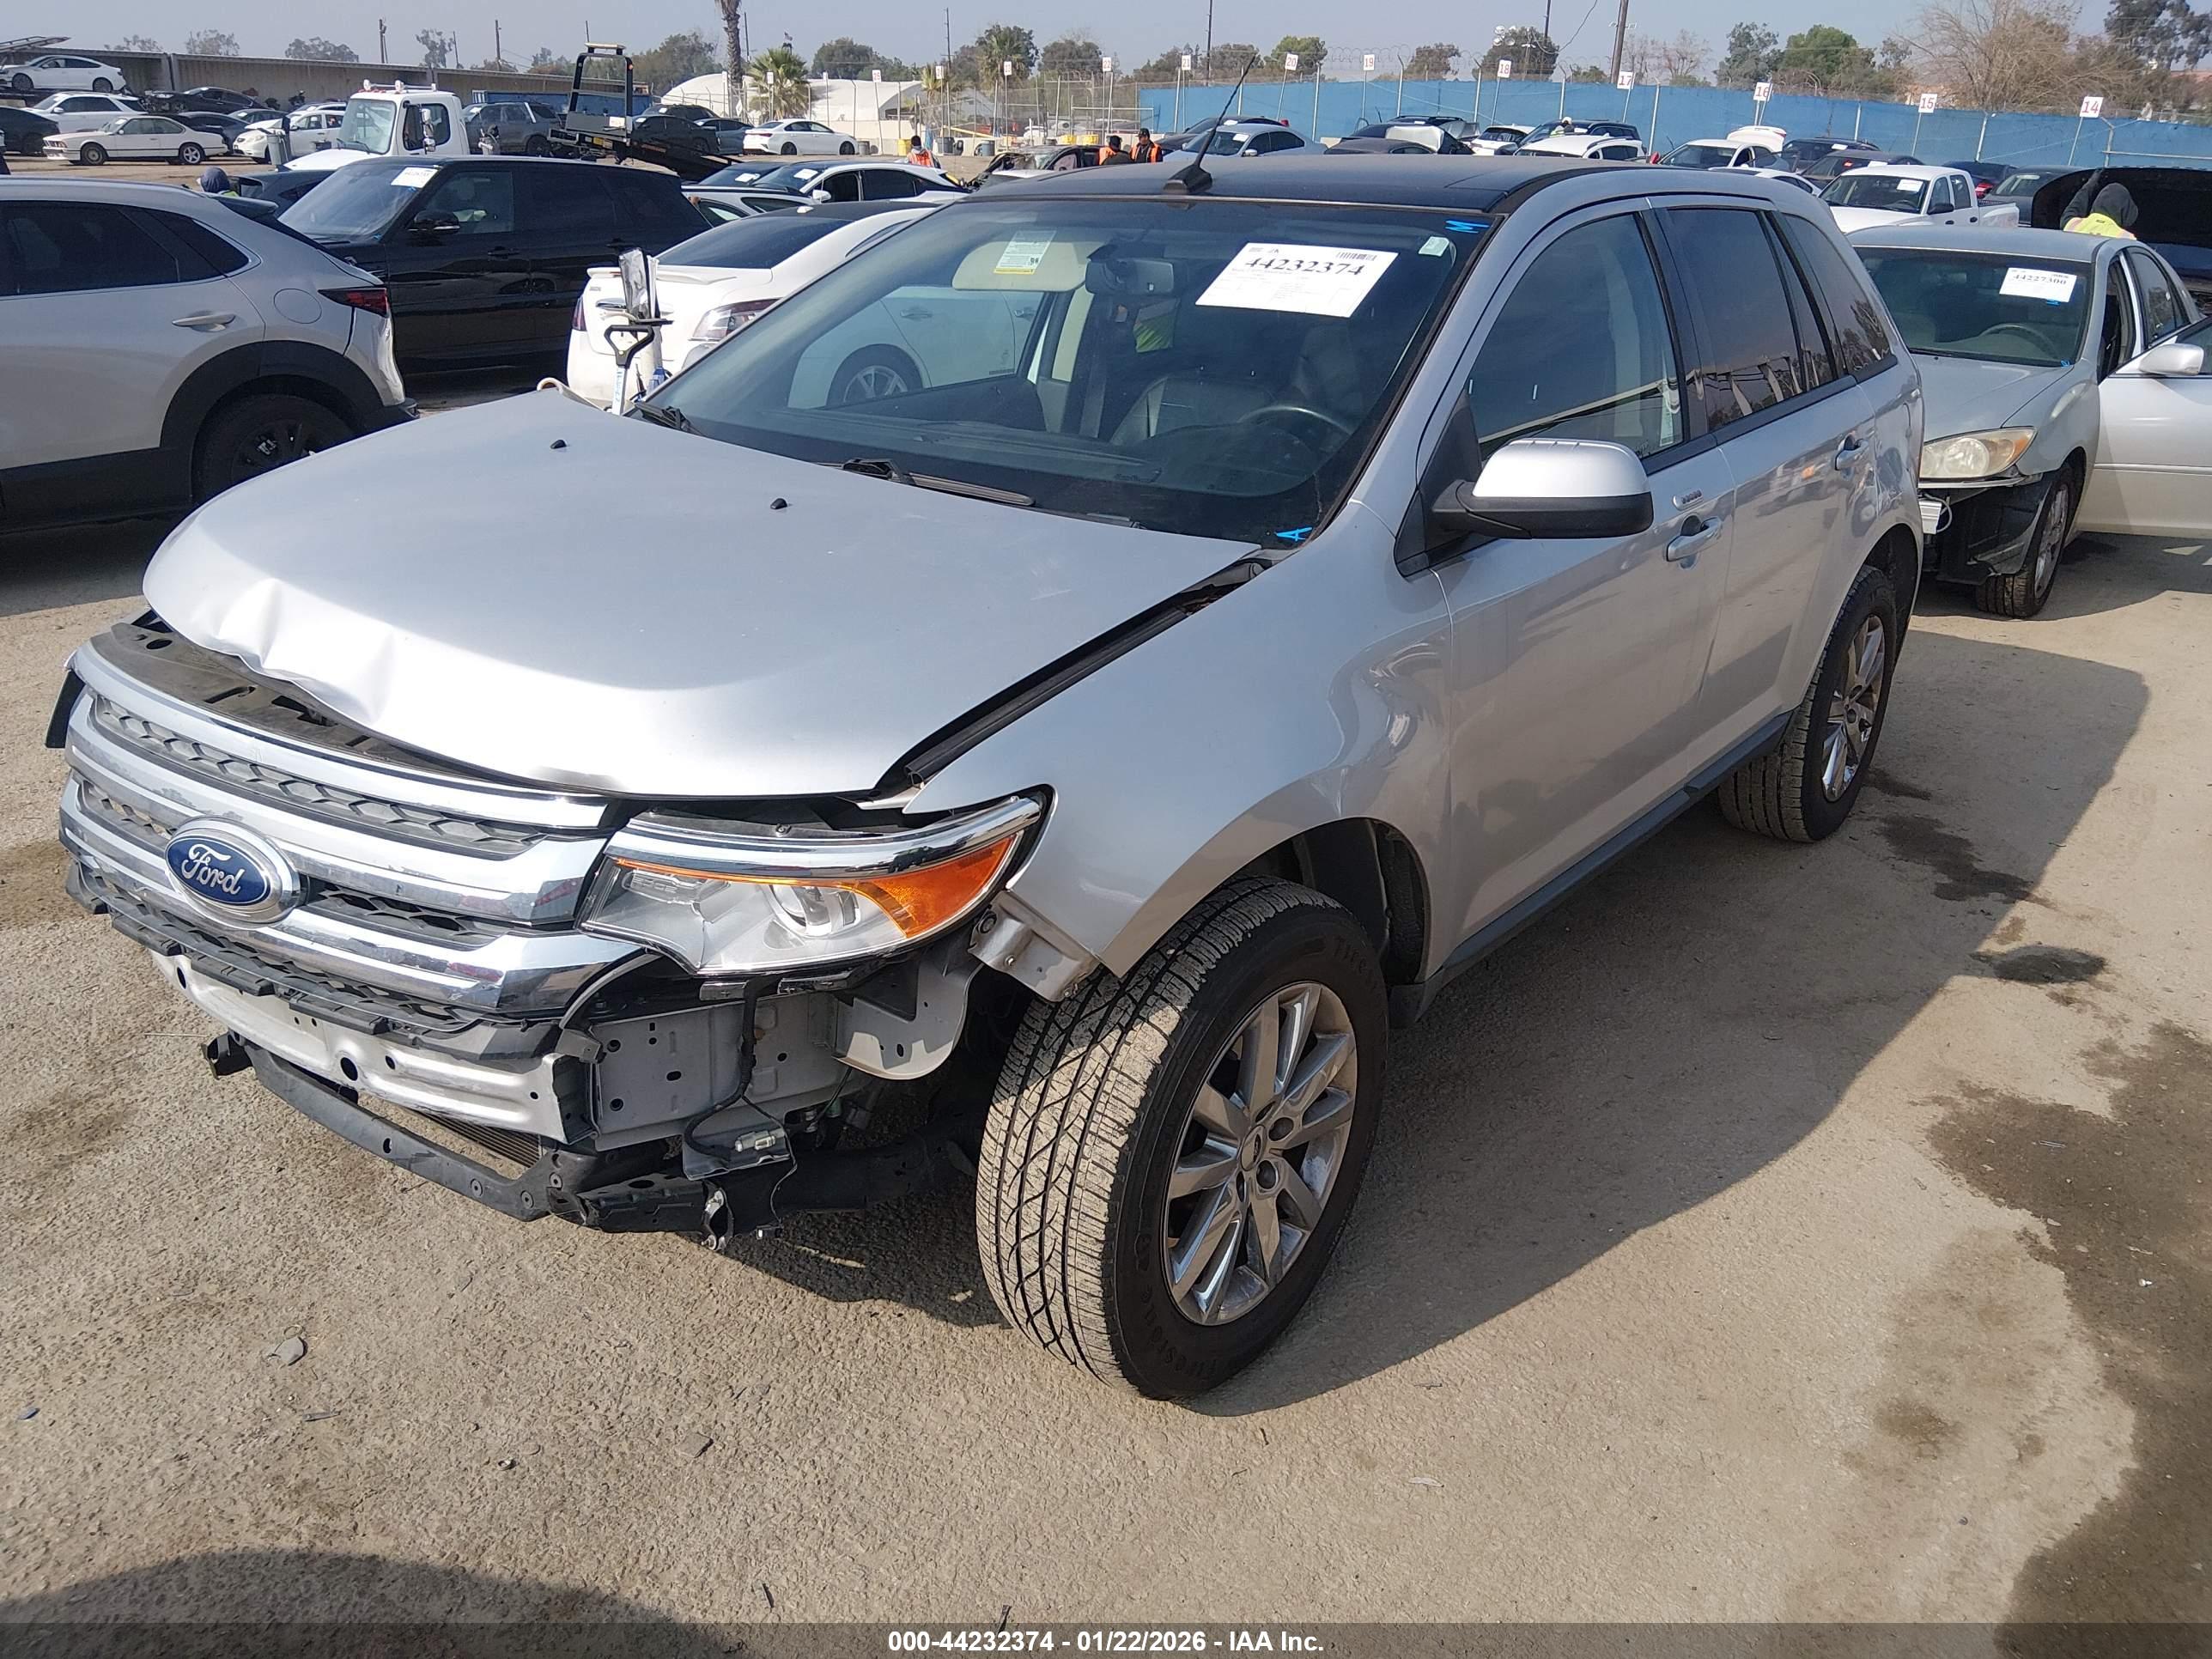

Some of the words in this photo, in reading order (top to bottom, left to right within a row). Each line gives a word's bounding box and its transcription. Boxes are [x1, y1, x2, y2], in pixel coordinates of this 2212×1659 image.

[1103, 60, 1111, 69] 22
[1182, 58, 1190, 68] 21
[1287, 56, 1297, 67] 20
[1365, 57, 1374, 68] 19
[1500, 64, 1510, 74] 18
[1619, 75, 1632, 86] 17
[1755, 87, 1769, 97] 16
[1920, 97, 1935, 109] 15
[2081, 100, 2099, 113] 14
[1244, 257, 1365, 276] 44232374
[181, 843, 246, 895] Ford
